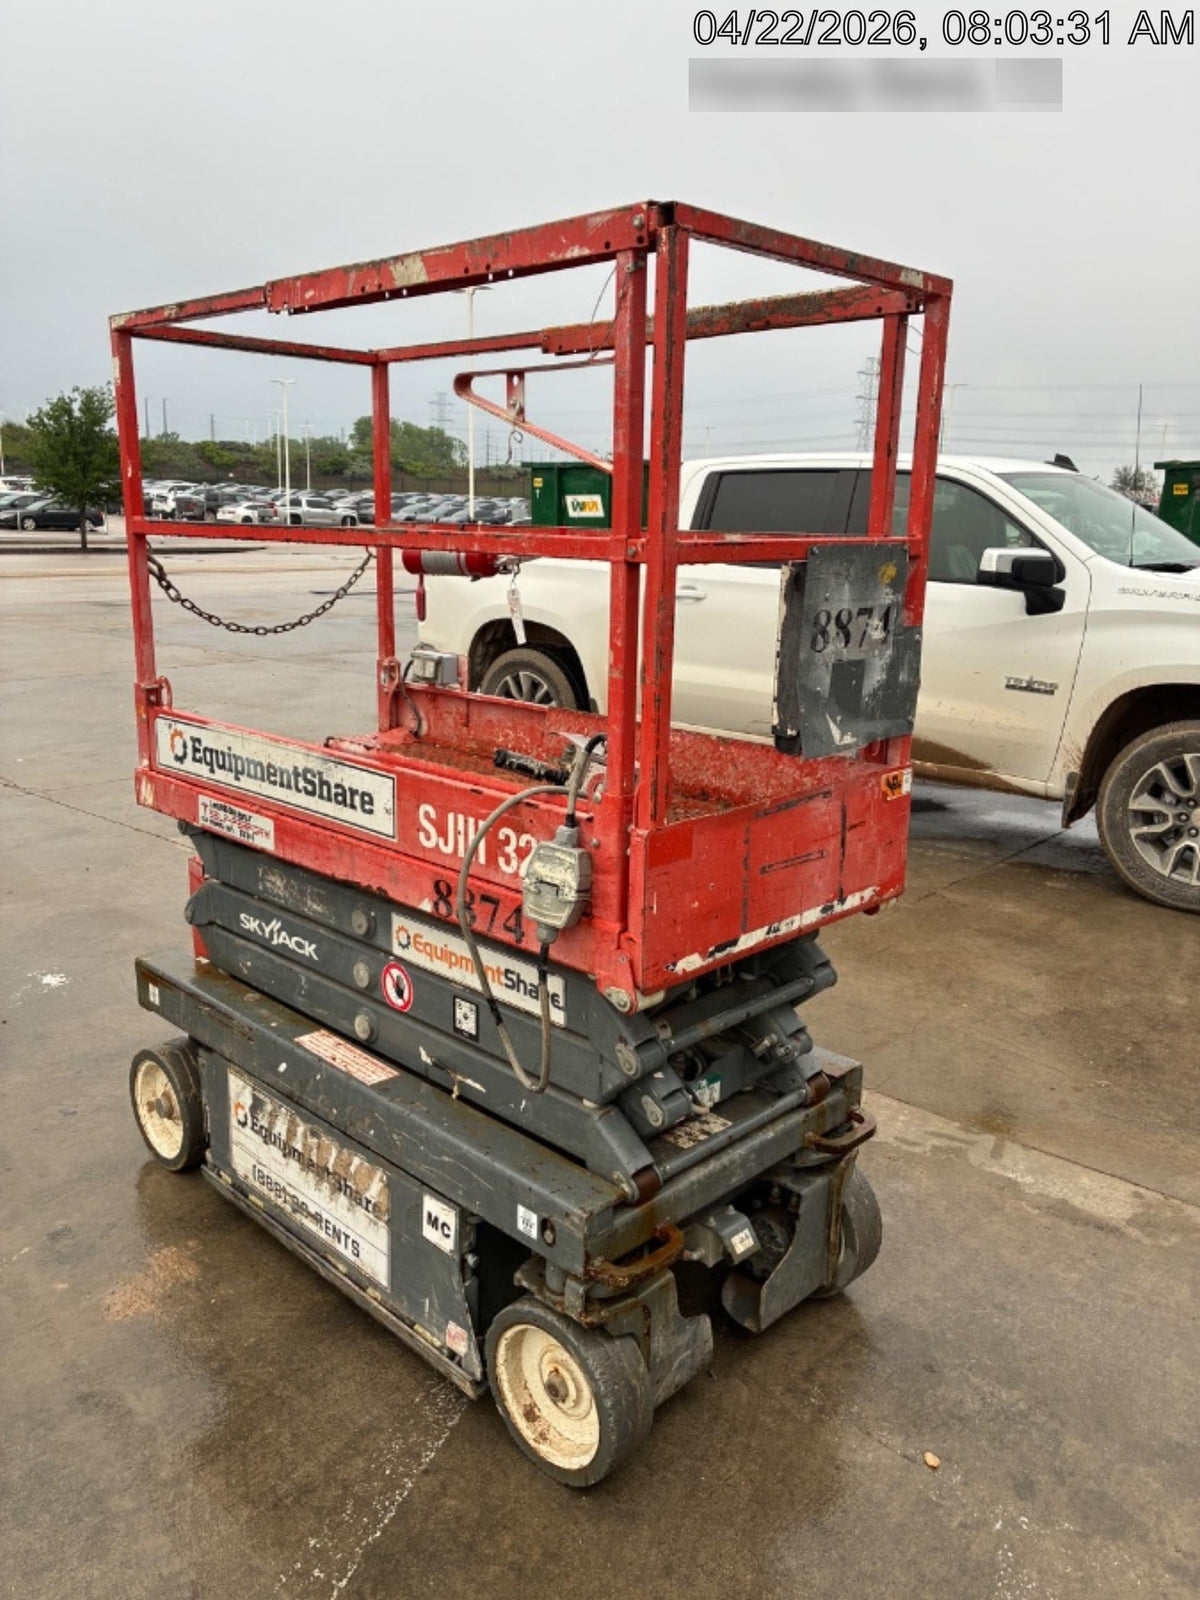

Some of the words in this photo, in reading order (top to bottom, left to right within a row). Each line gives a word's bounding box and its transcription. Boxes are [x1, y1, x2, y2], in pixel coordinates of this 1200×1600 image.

[189, 735, 375, 815] EquipmentShare
[239, 913, 318, 961] SKYJACK
[412, 933, 564, 1010] EquipmntShae
[426, 1210, 451, 1239] MC
